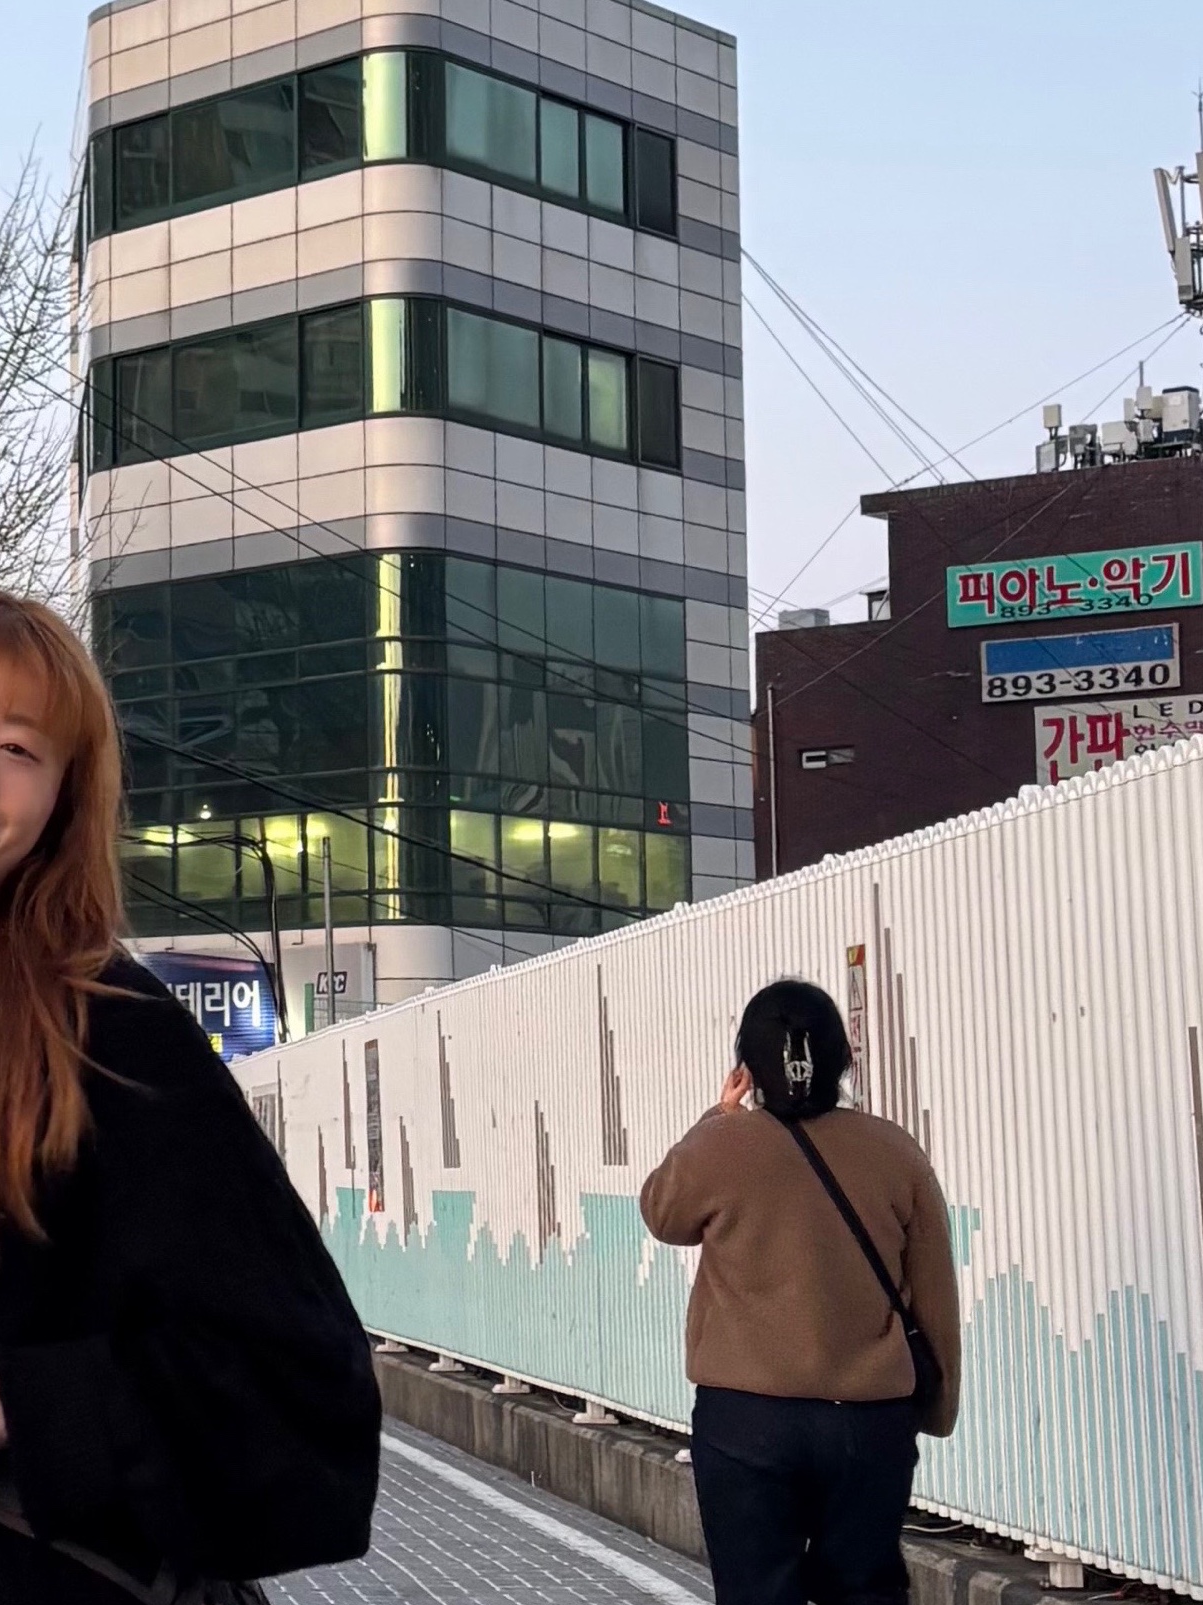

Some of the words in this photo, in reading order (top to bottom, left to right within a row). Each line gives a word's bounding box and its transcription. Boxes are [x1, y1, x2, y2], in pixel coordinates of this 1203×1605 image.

[987, 663, 1171, 699] 893-3340
[319, 973, 345, 992] KC
[168, 980, 260, 1027] 테리어
